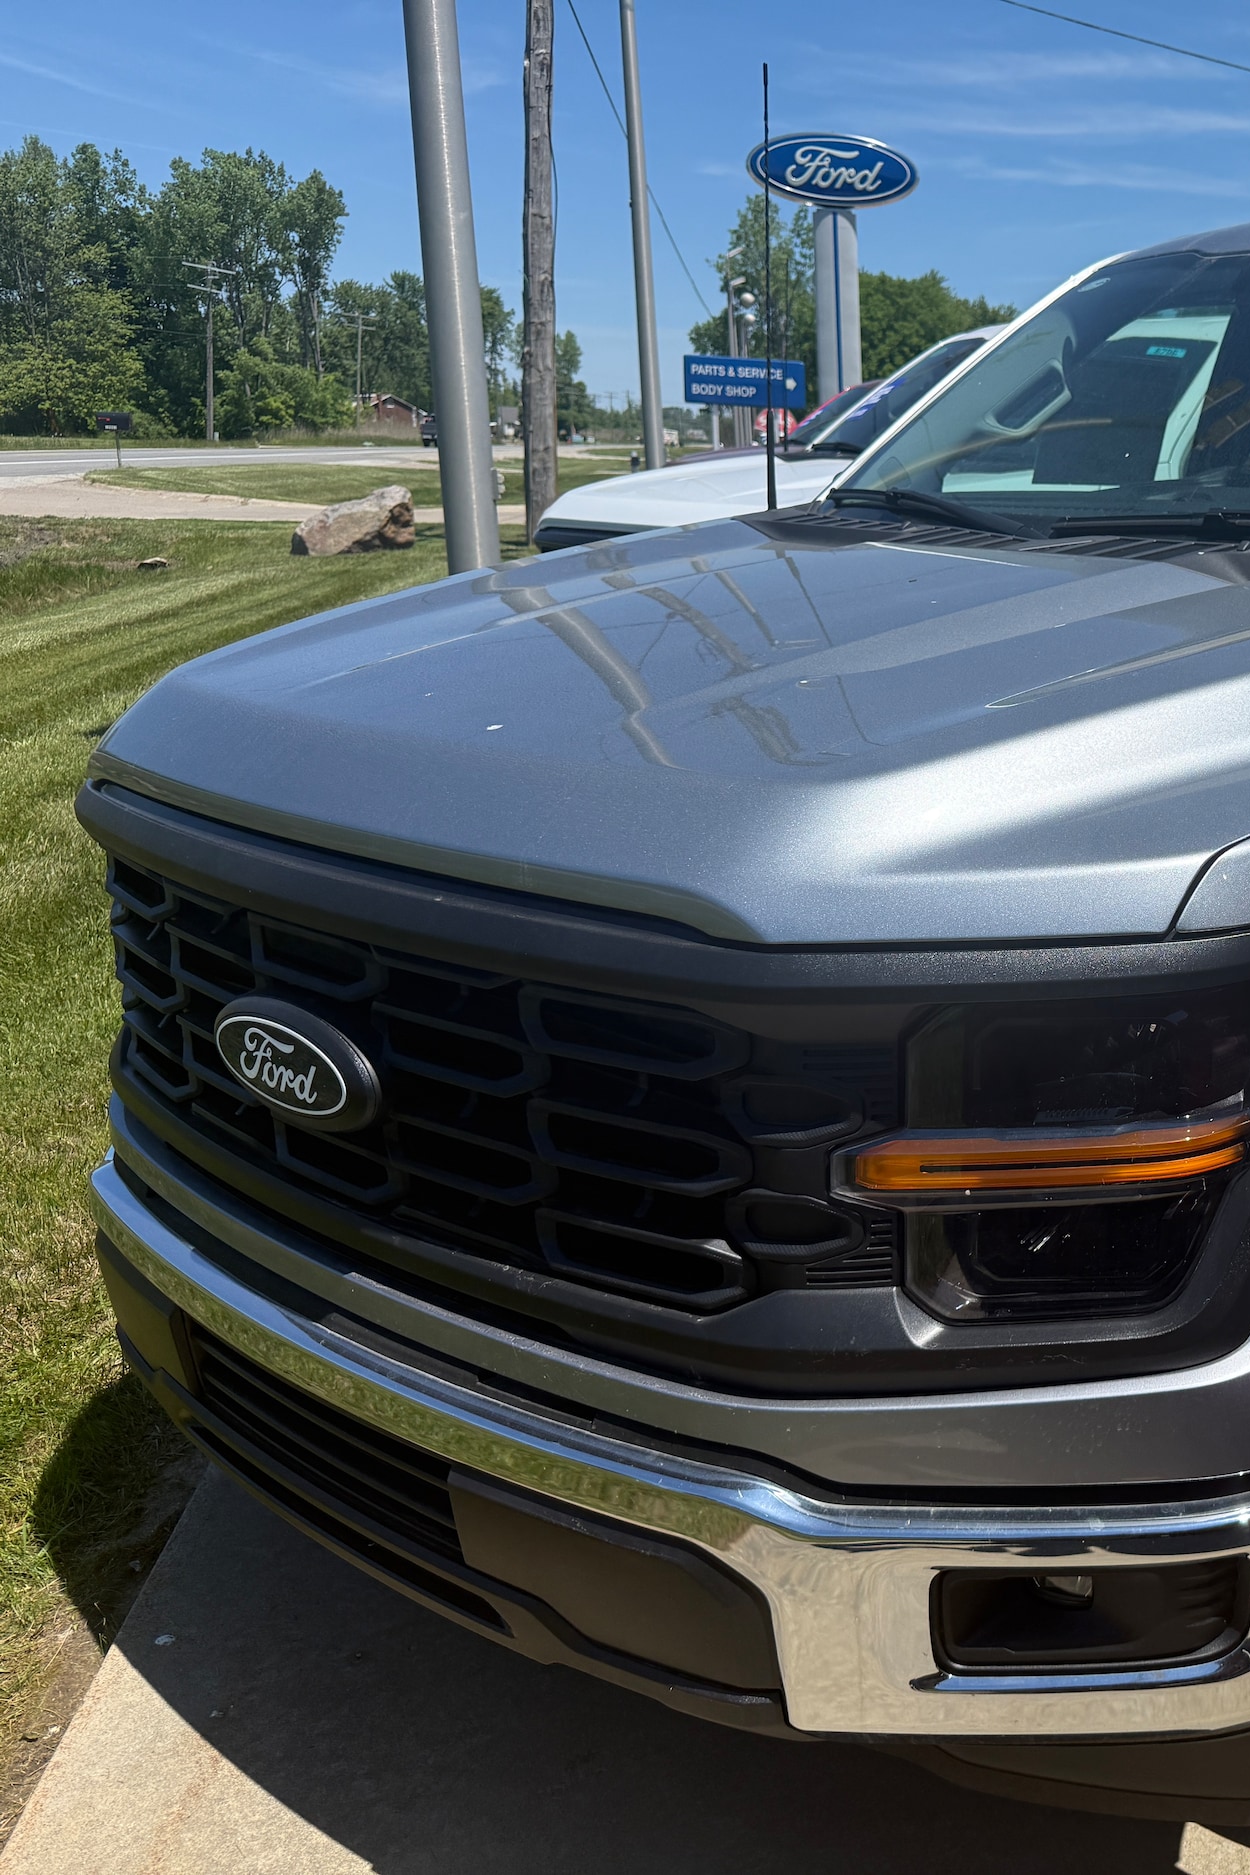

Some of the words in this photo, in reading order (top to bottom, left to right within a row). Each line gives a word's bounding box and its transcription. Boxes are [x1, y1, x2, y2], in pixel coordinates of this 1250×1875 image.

[785, 146, 884, 191] Ford
[690, 364, 726, 377] PARTS
[727, 366, 736, 378] &
[737, 367, 784, 380] SERVCE
[691, 383, 724, 396] BODY
[725, 385, 757, 398] SHOP
[240, 1027, 318, 1104] Ford
